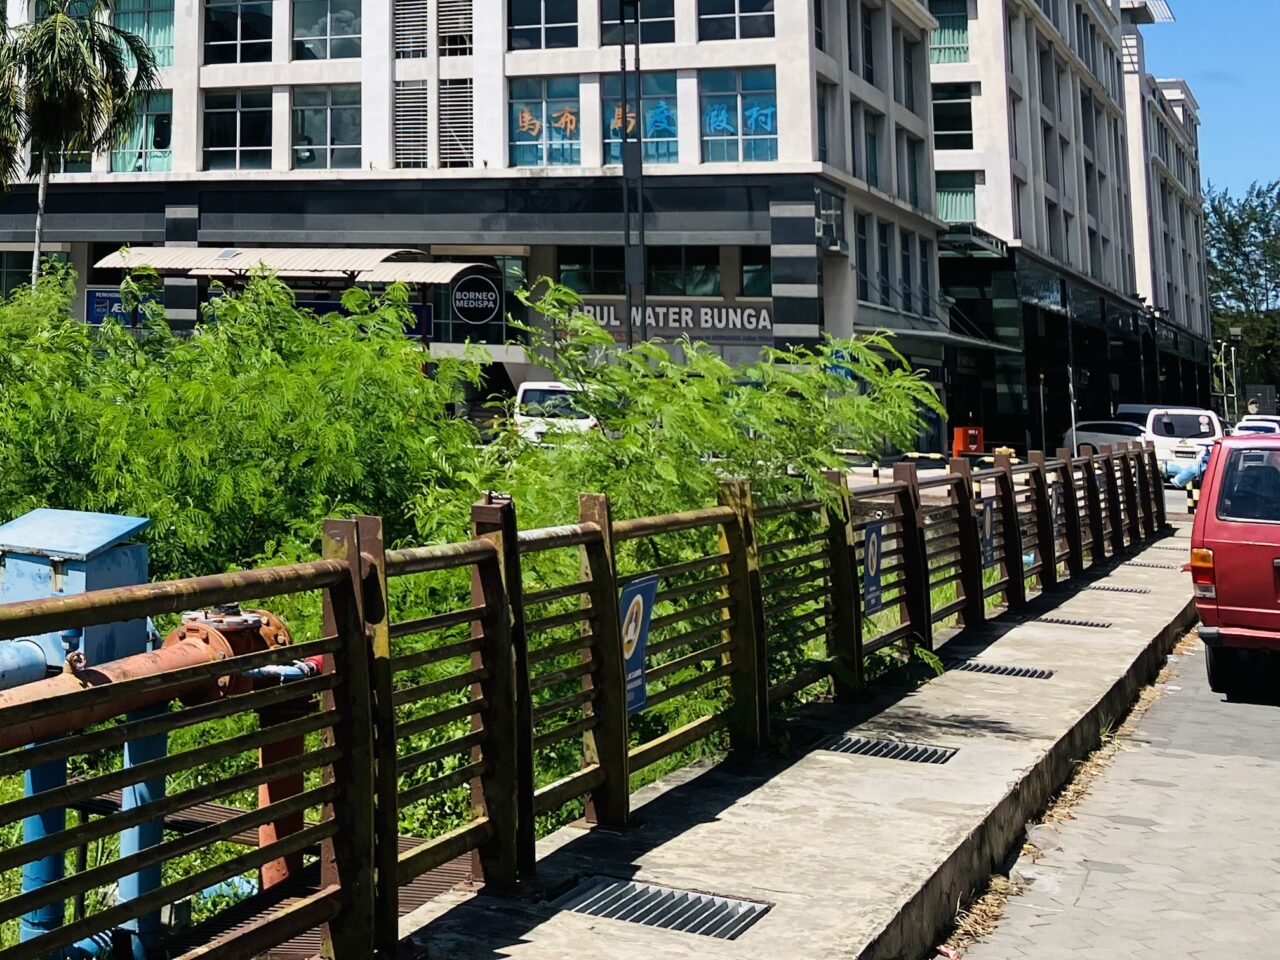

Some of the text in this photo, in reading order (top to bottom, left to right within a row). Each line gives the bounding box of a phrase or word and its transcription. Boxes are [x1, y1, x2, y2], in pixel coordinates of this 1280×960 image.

[455, 292, 496, 301] BORNEO
[455, 300, 495, 308] MEDISPA
[631, 306, 694, 328] WATER
[700, 307, 772, 330] BUNGA
